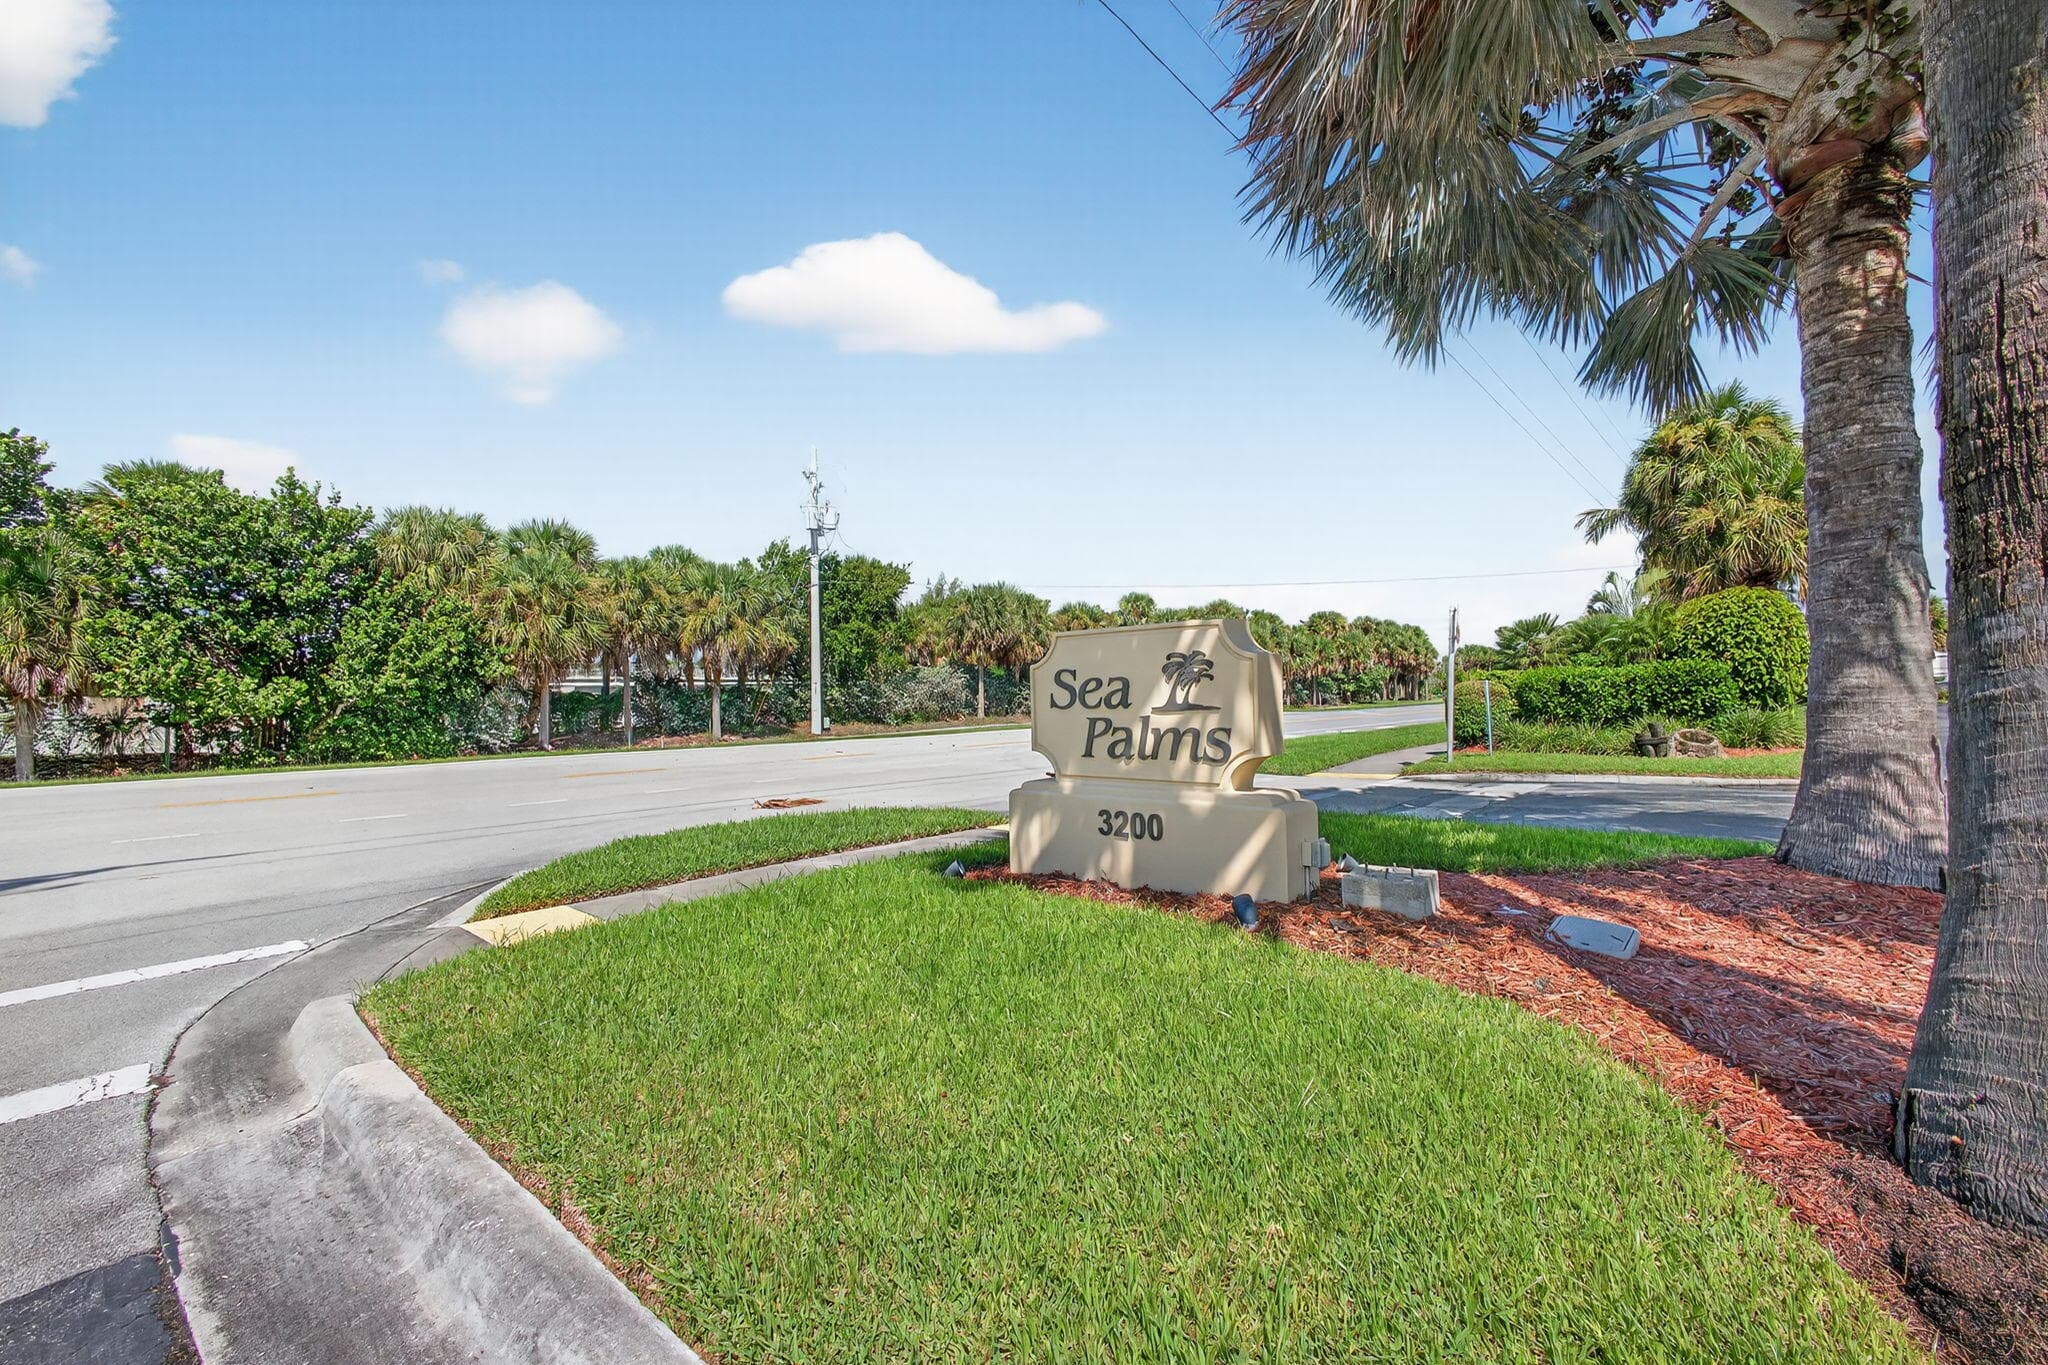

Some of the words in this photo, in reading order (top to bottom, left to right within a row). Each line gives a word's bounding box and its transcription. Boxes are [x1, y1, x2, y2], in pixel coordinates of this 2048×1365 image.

[1050, 669, 1132, 710] Sea
[1082, 715, 1232, 766] Palms
[1098, 809, 1164, 841] 3200
